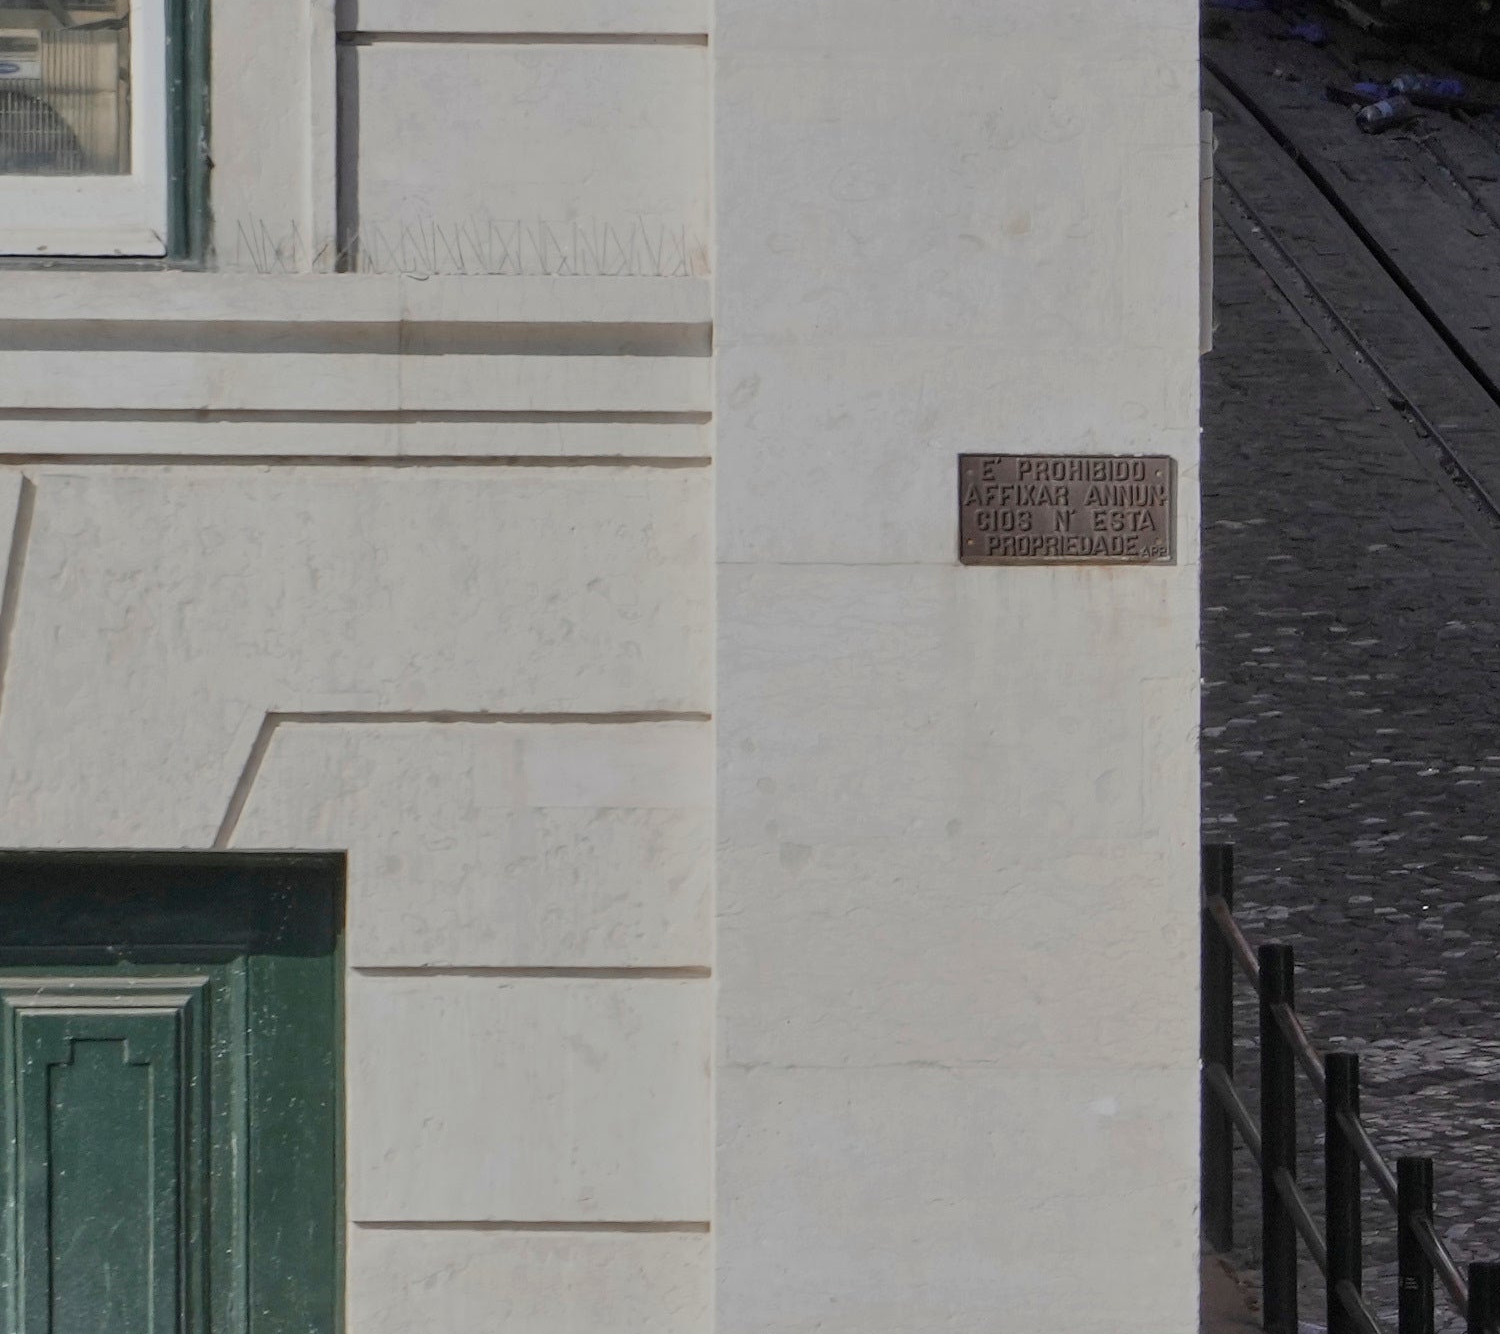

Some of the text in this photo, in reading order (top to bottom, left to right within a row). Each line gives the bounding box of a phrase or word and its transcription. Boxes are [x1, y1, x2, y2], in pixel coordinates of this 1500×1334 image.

[1016, 458, 1146, 482] PROHIBIDO
[963, 484, 1070, 507] AFFIXAR
[975, 509, 1033, 532] CIOS
[1091, 509, 1156, 532] ESTA
[985, 534, 1140, 557] PROPRIEDADE
